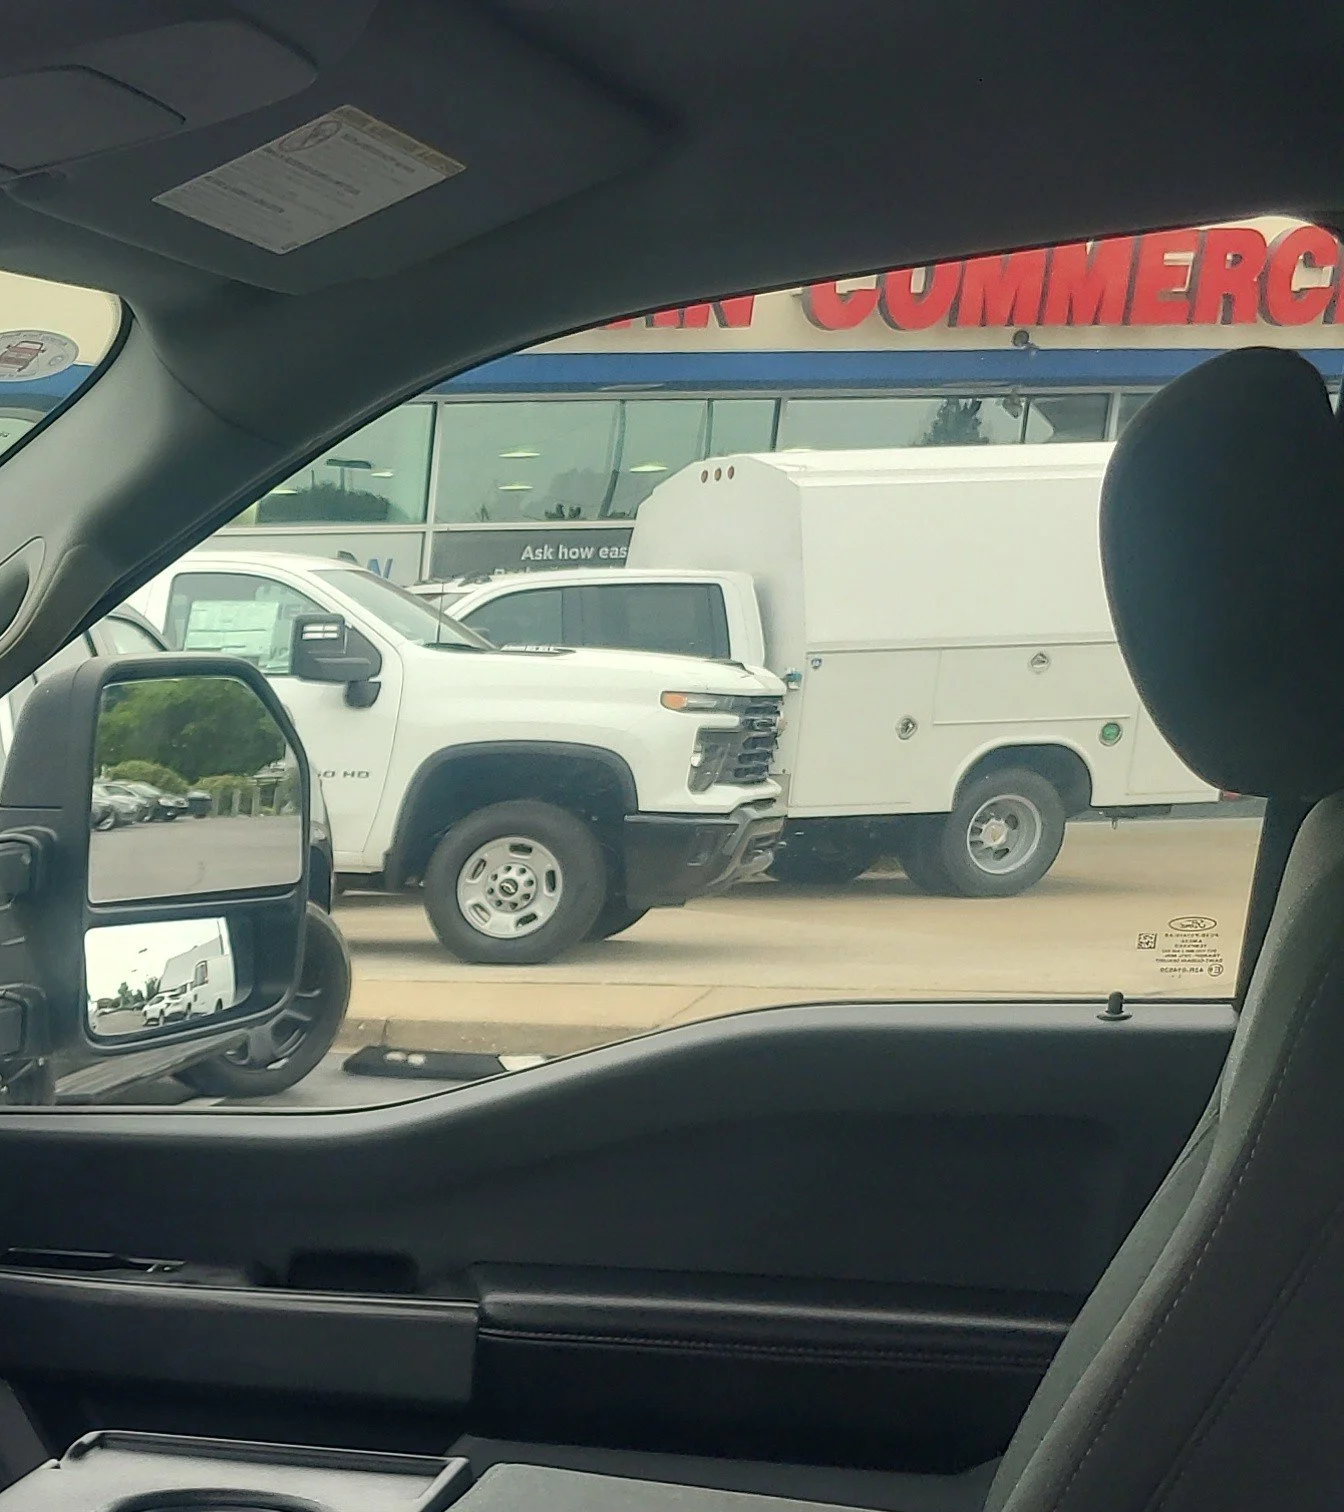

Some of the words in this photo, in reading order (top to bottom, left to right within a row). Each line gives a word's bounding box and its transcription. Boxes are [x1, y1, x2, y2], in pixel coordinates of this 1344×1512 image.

[800, 226, 1344, 332] COMMERC
[521, 544, 553, 561] Ask
[558, 544, 594, 560] how
[599, 546, 628, 560] eas
[342, 770, 370, 779] HD
